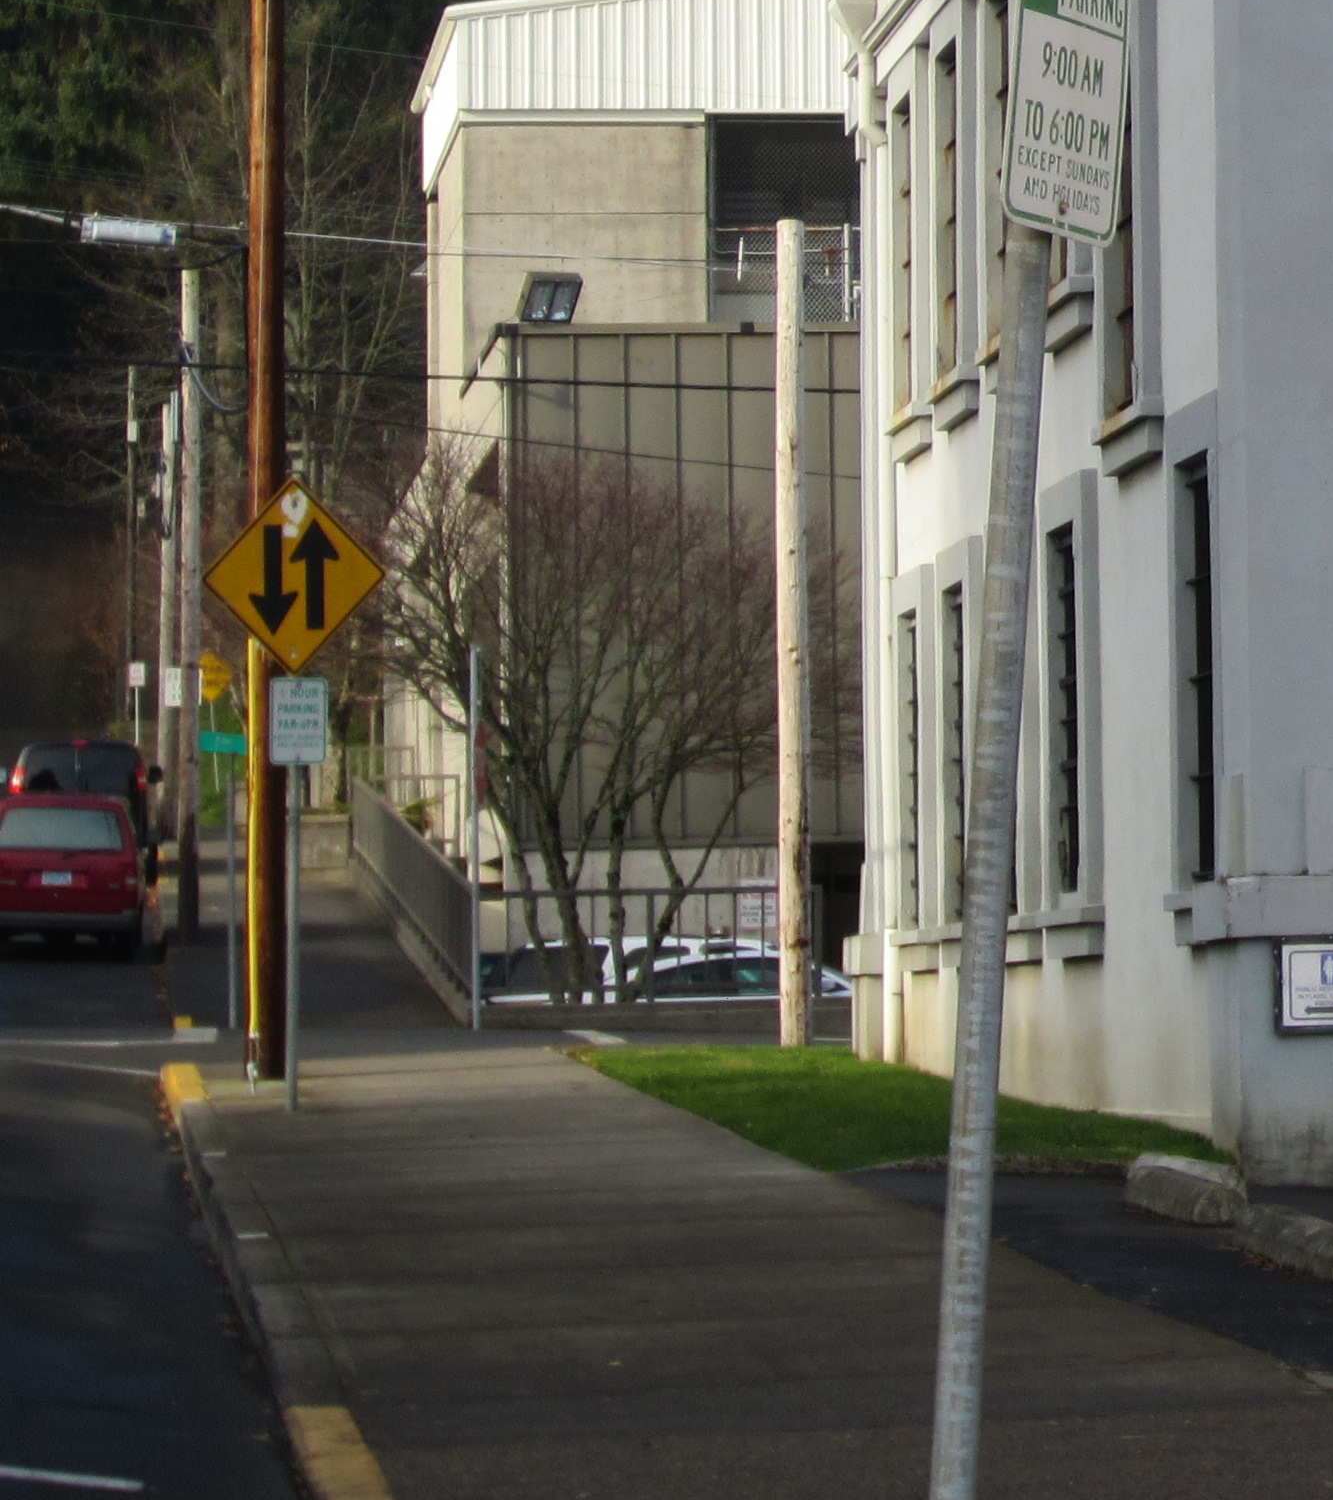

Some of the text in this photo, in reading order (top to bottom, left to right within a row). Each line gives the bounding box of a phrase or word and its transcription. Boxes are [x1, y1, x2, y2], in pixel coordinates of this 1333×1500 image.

[1042, 41, 1105, 98] 9:00 AM
[1024, 98, 1110, 162] TO 6:00 PM
[1017, 145, 1110, 190] EXCEPT SUNDAYS
[1023, 175, 1101, 216] AND HOLIDAYS
